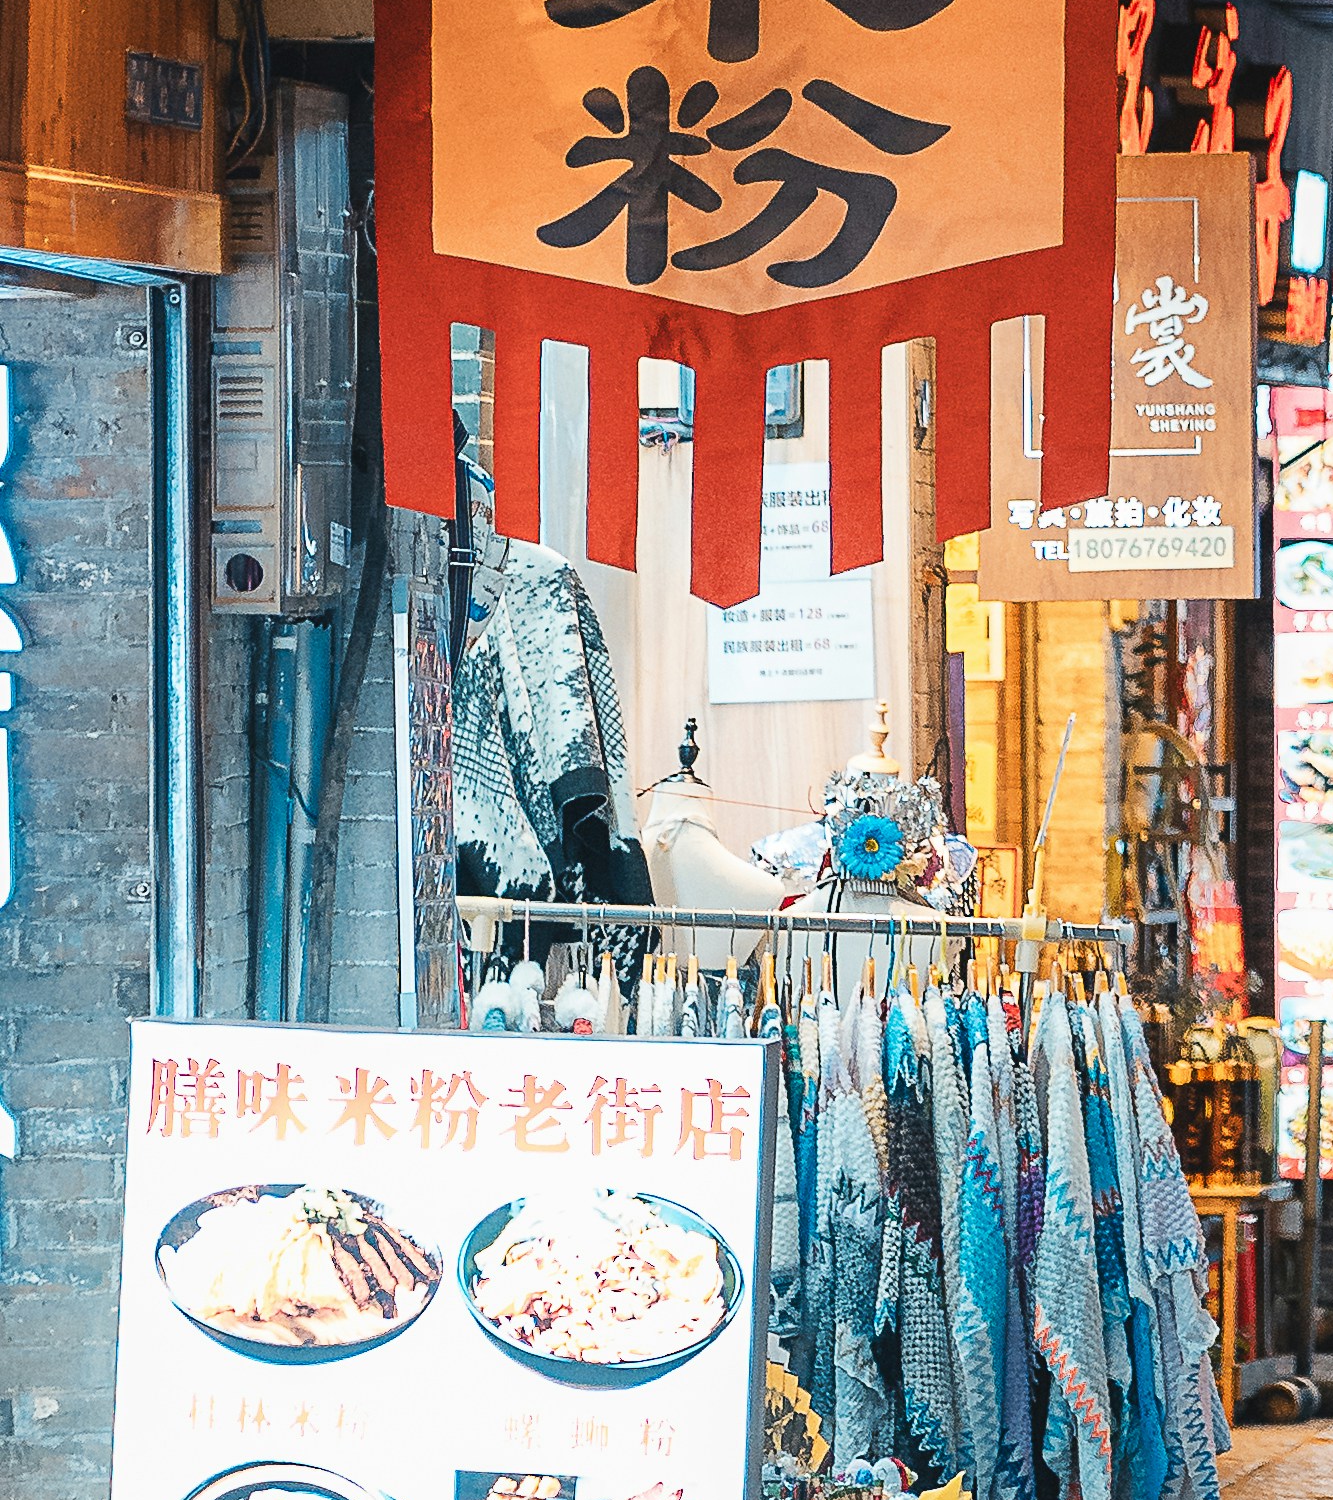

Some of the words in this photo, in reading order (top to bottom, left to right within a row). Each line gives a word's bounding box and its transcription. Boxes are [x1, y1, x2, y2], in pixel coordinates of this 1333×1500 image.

[1124, 275, 1214, 389] 裳
[1135, 403, 1216, 417] YUNSHANG
[1149, 418, 1217, 432] SHEYING
[1074, 536, 1227, 559] 18076769420
[145, 1055, 751, 1162] 膳味米粉老街店
